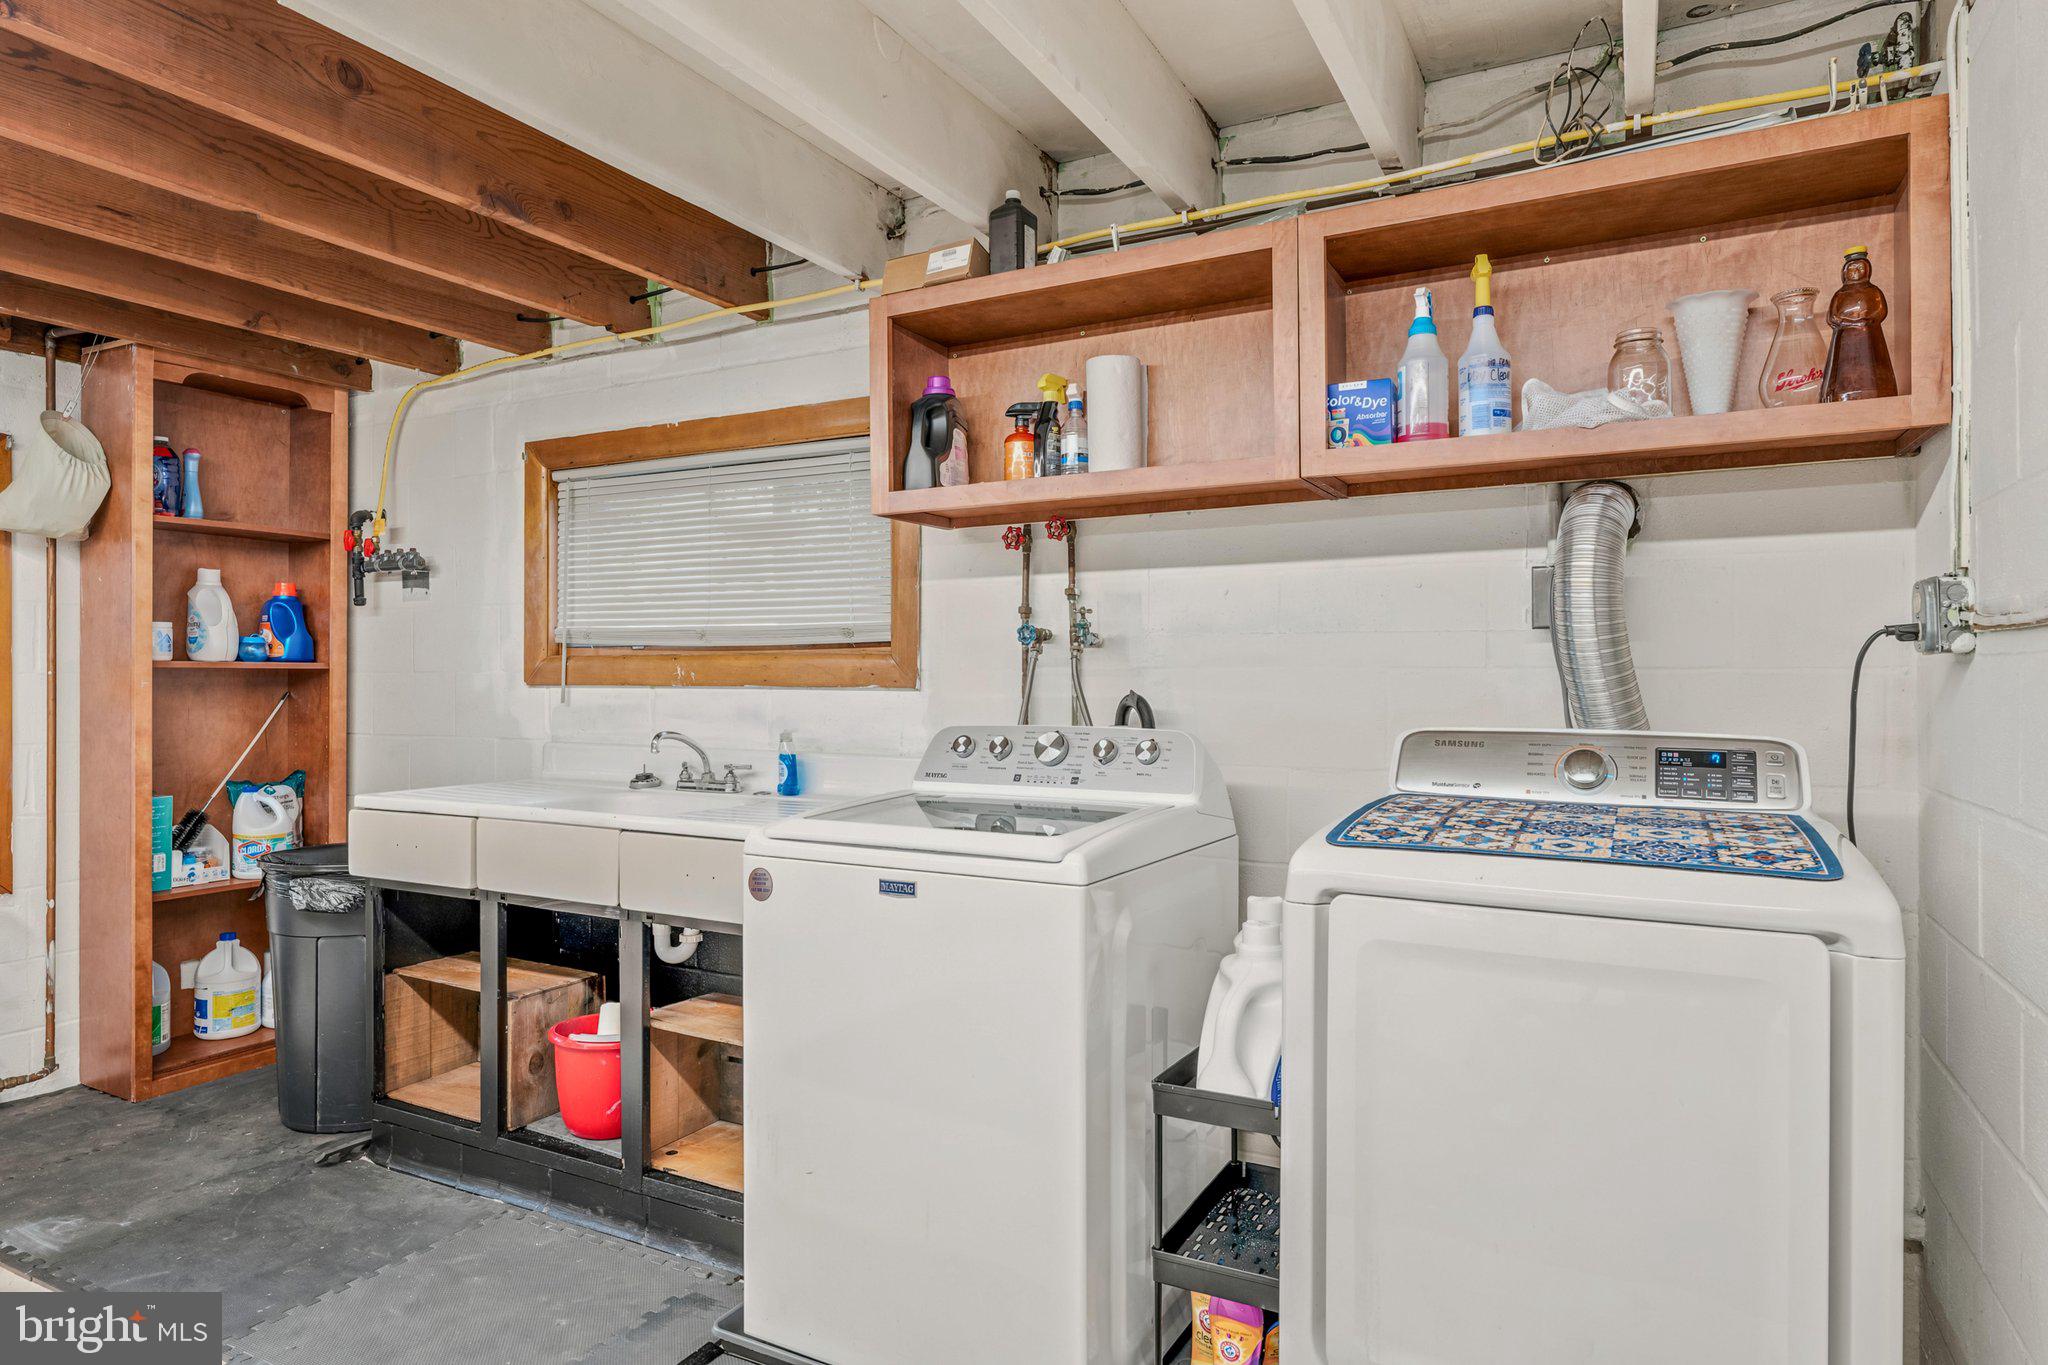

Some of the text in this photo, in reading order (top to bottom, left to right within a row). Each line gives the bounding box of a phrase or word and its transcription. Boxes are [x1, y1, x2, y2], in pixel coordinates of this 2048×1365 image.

[1327, 395, 1387, 410] olor&Dye
[1356, 411, 1387, 420] Absorber
[1434, 740, 1485, 748] SAMSUNG
[240, 846, 266, 854] CLOROX
[880, 883, 914, 893] MAYTAG
